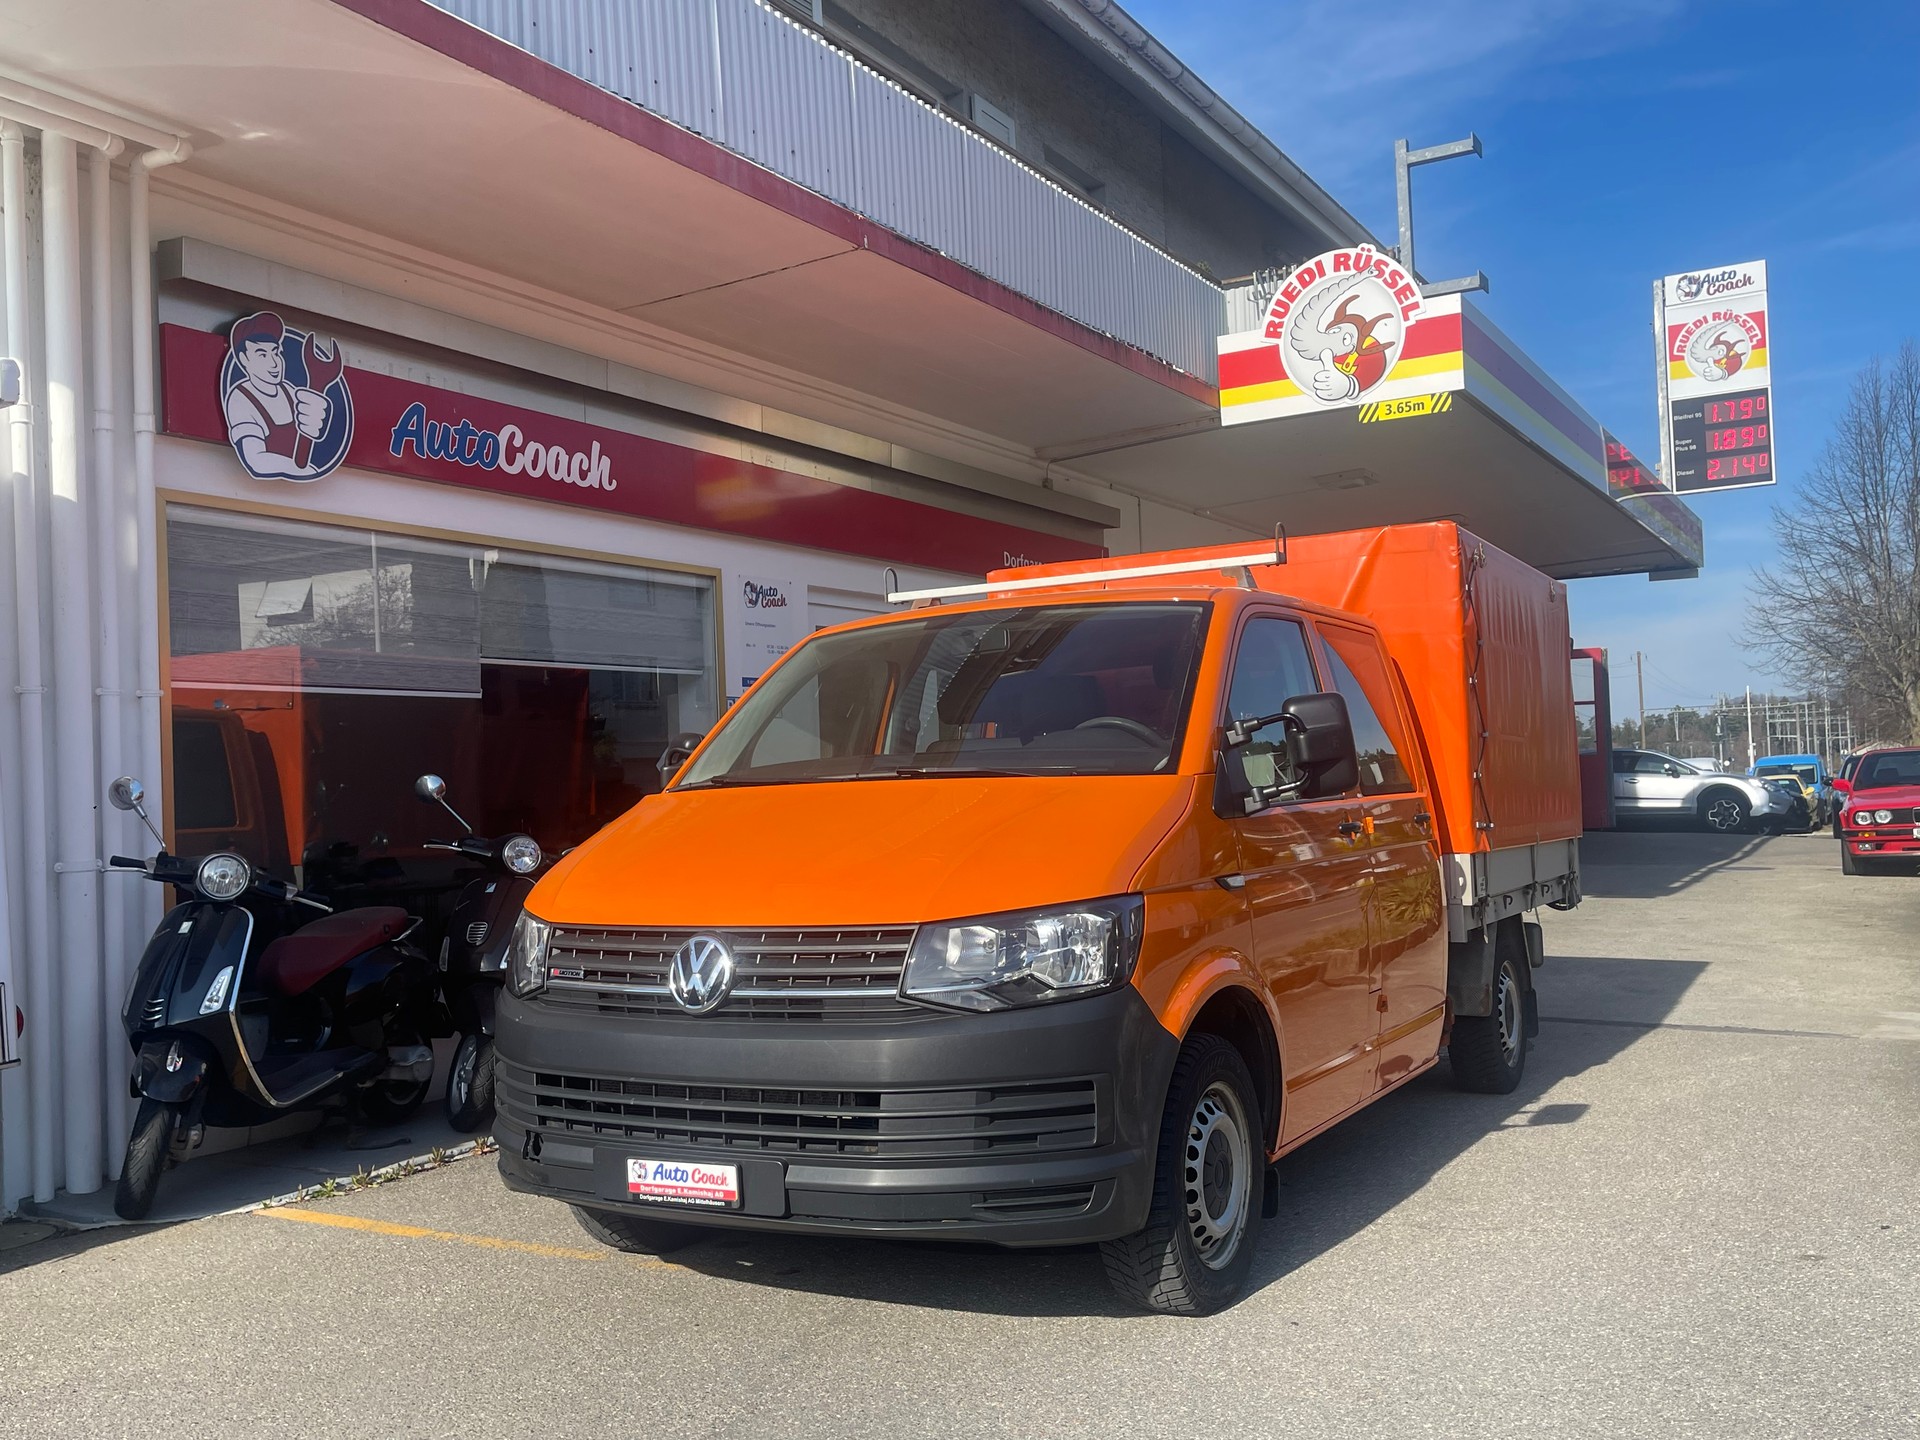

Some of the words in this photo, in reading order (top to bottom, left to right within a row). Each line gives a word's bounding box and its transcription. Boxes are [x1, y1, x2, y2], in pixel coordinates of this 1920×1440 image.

[1700, 269, 1737, 288] Auto
[1706, 273, 1755, 296] Coach
[1264, 260, 1327, 340] RUEDI
[1333, 246, 1422, 324] RÜSSEL
[1676, 314, 1708, 355] RUEDI
[1711, 308, 1762, 346] RÜSSEL
[1384, 401, 1425, 416] 3.65m
[1675, 438, 1692, 446] Super
[1676, 469, 1695, 477] Diesel
[757, 585, 778, 598] Auto
[761, 594, 788, 609] Coach
[653, 1163, 689, 1183] Auto
[691, 1168, 729, 1187] Coach
[640, 1184, 677, 1195] Dorfgarage
